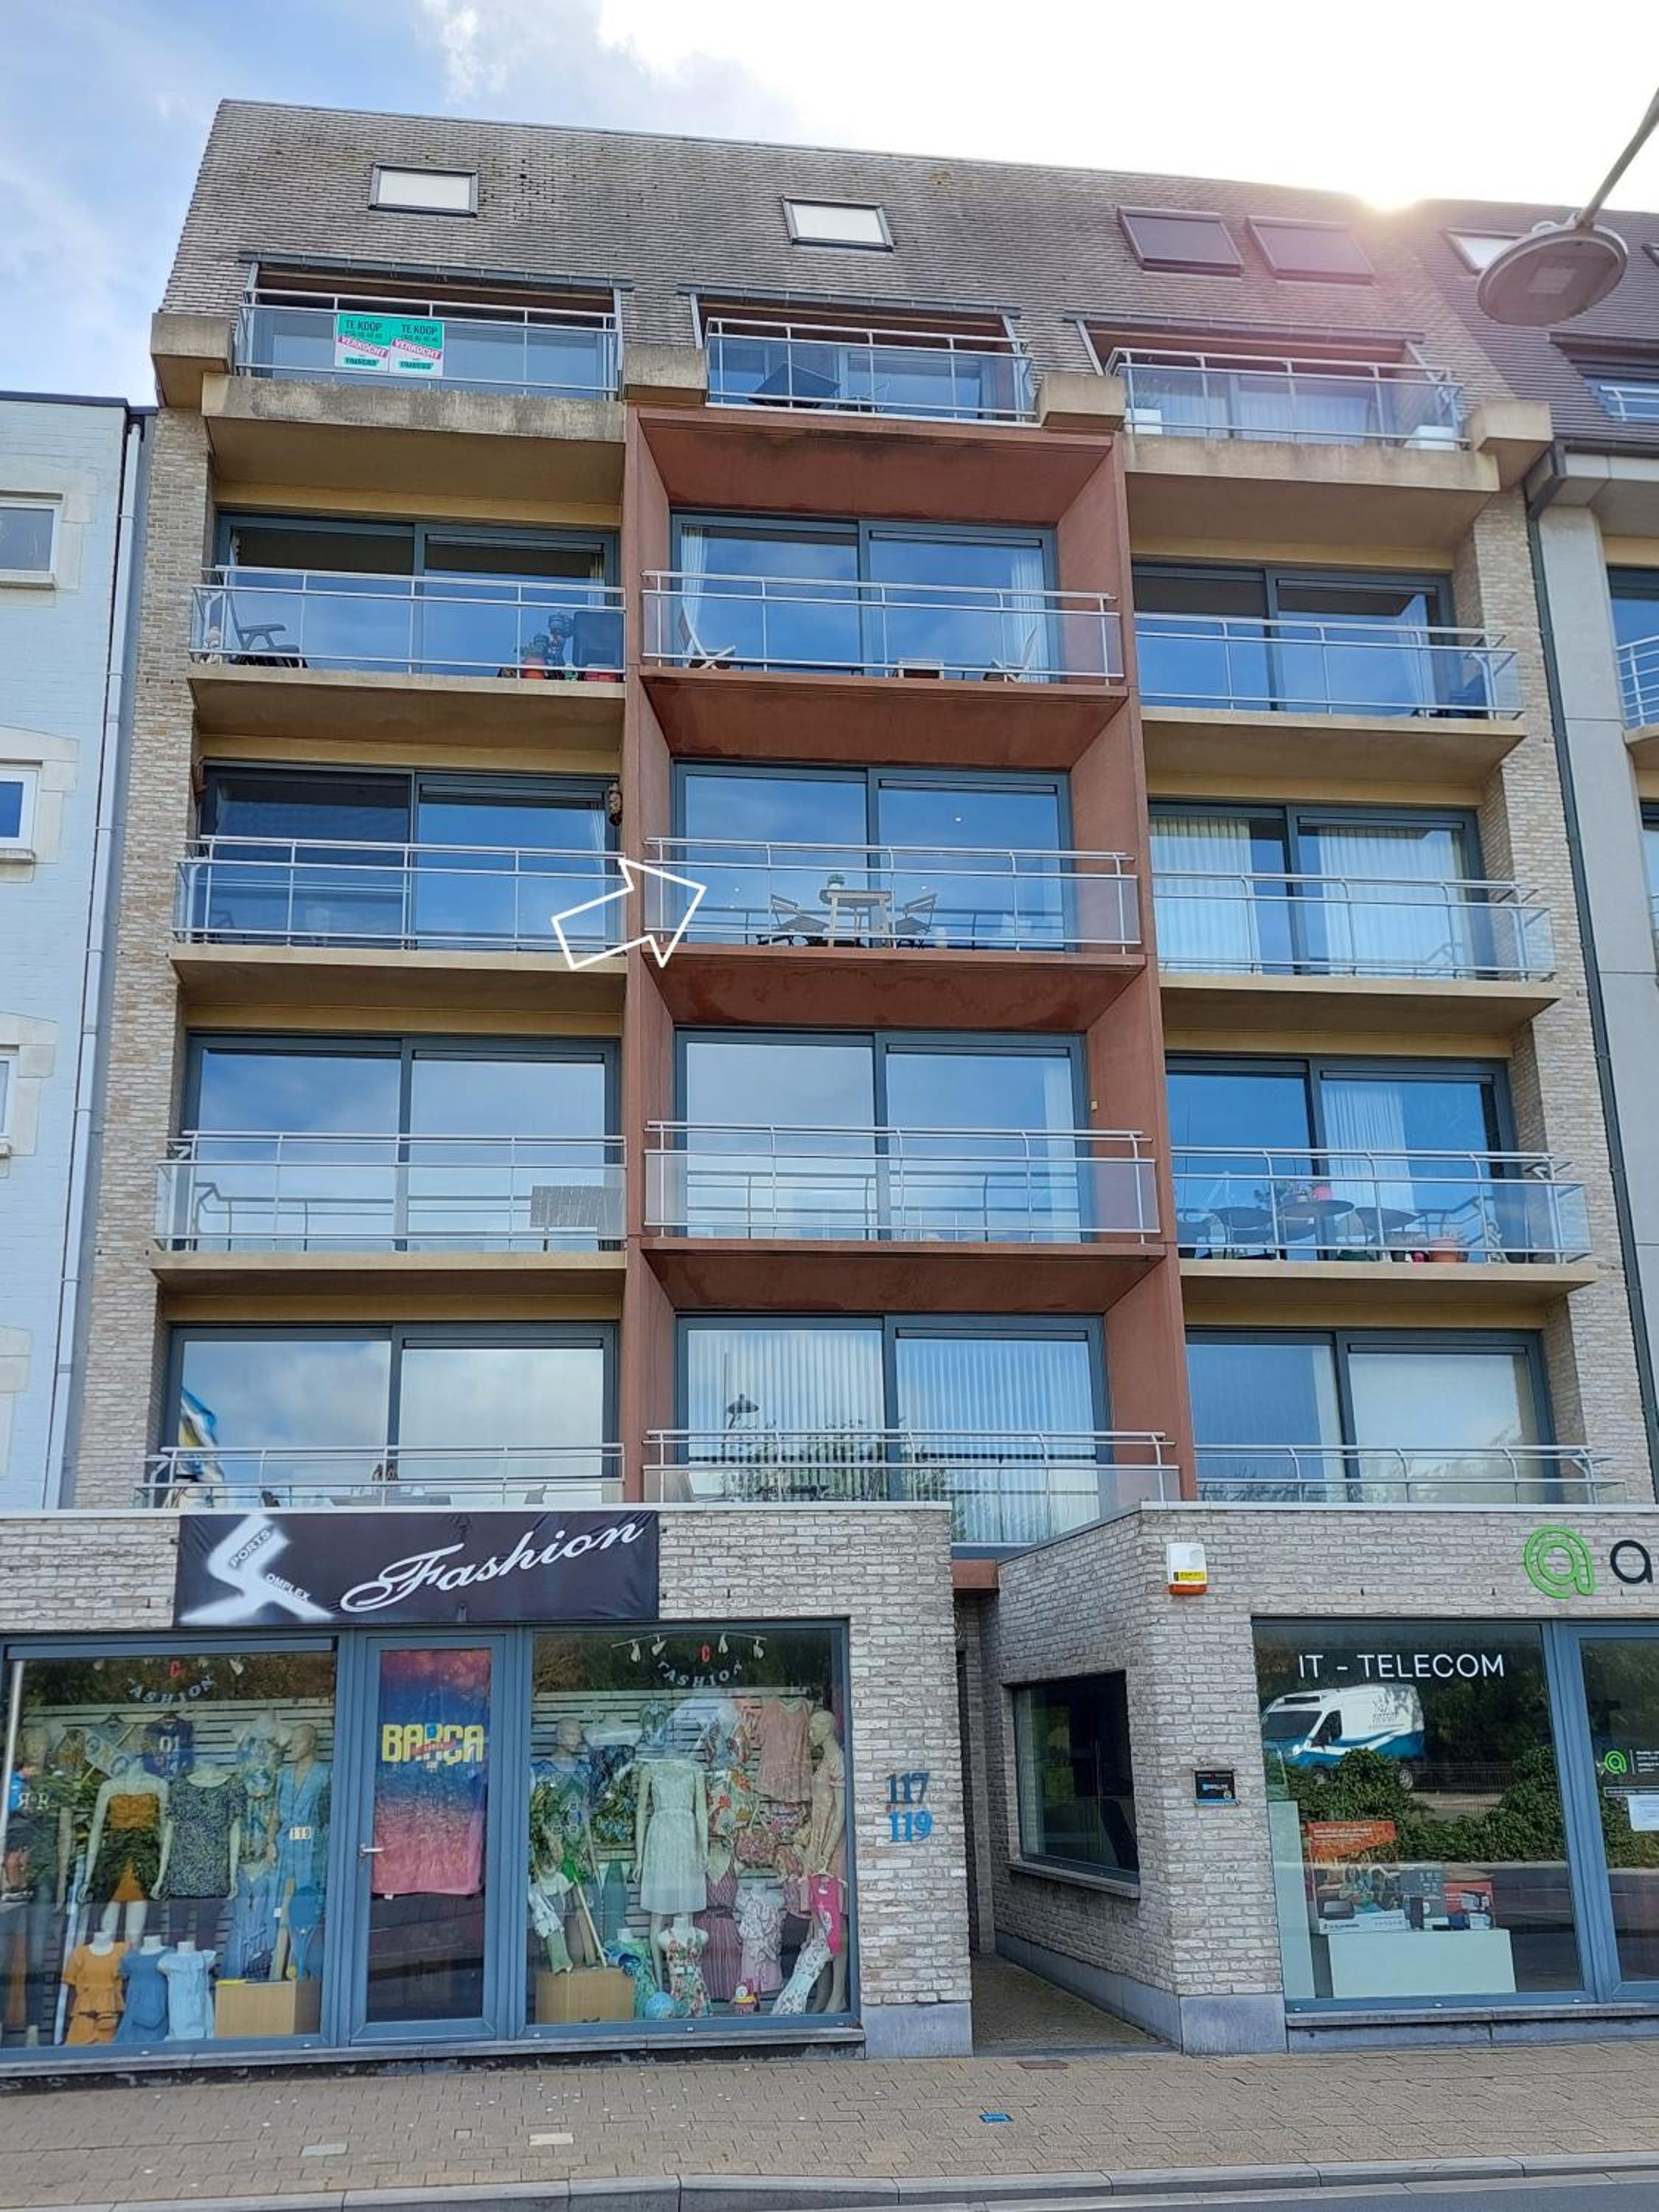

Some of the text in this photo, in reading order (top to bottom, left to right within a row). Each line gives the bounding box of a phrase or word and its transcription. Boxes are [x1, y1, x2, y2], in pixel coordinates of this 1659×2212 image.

[358, 320, 382, 331] KOOP
[414, 324, 437, 335] KOOP
[229, 1528, 271, 1568] PORTS
[340, 1522, 644, 1612] Fashion
[266, 1573, 310, 1601] OMPLEX
[1299, 1654, 1324, 1678] IT
[1356, 1653, 1505, 1678] TELECOM
[886, 1771, 930, 1804] 117
[888, 1810, 933, 1842] 119
